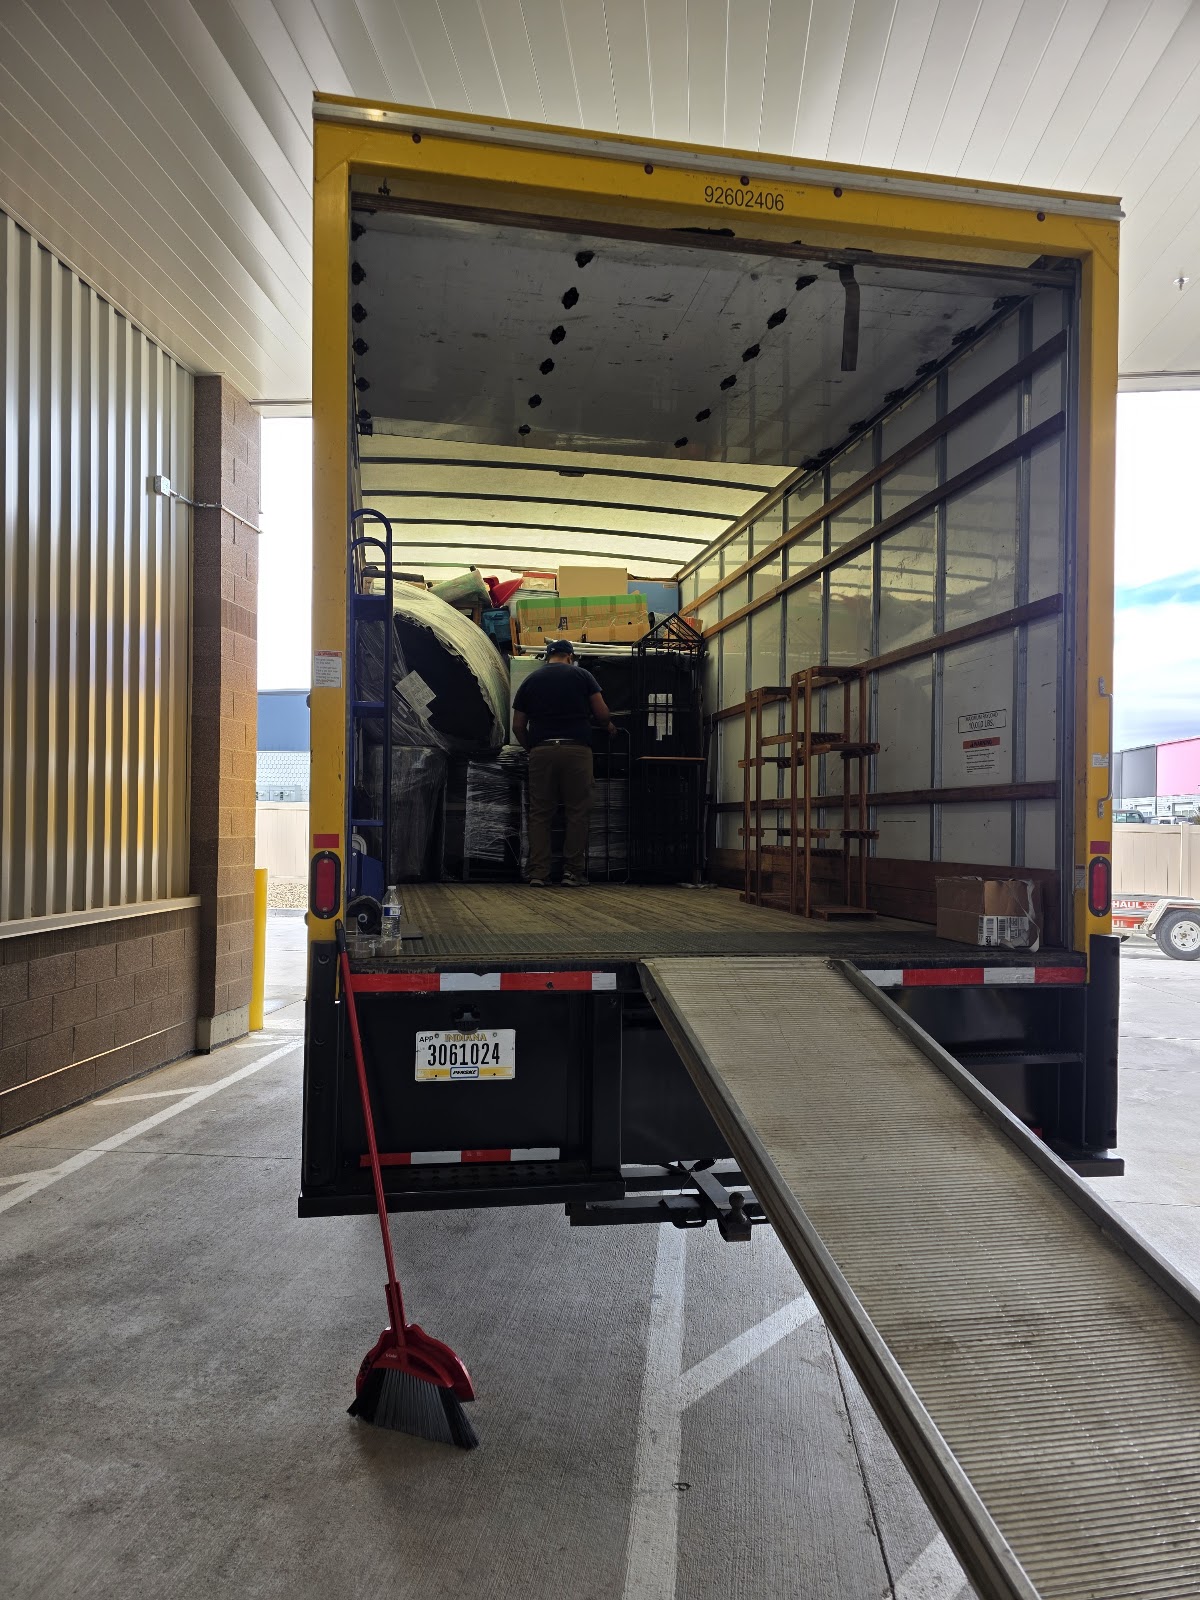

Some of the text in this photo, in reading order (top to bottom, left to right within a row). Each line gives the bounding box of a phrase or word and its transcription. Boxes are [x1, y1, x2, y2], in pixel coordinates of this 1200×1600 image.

[704, 185, 784, 211] 92602406
[1112, 900, 1142, 909] HAUL
[444, 1033, 487, 1042] INDIANA
[427, 1043, 500, 1066] 3061024
